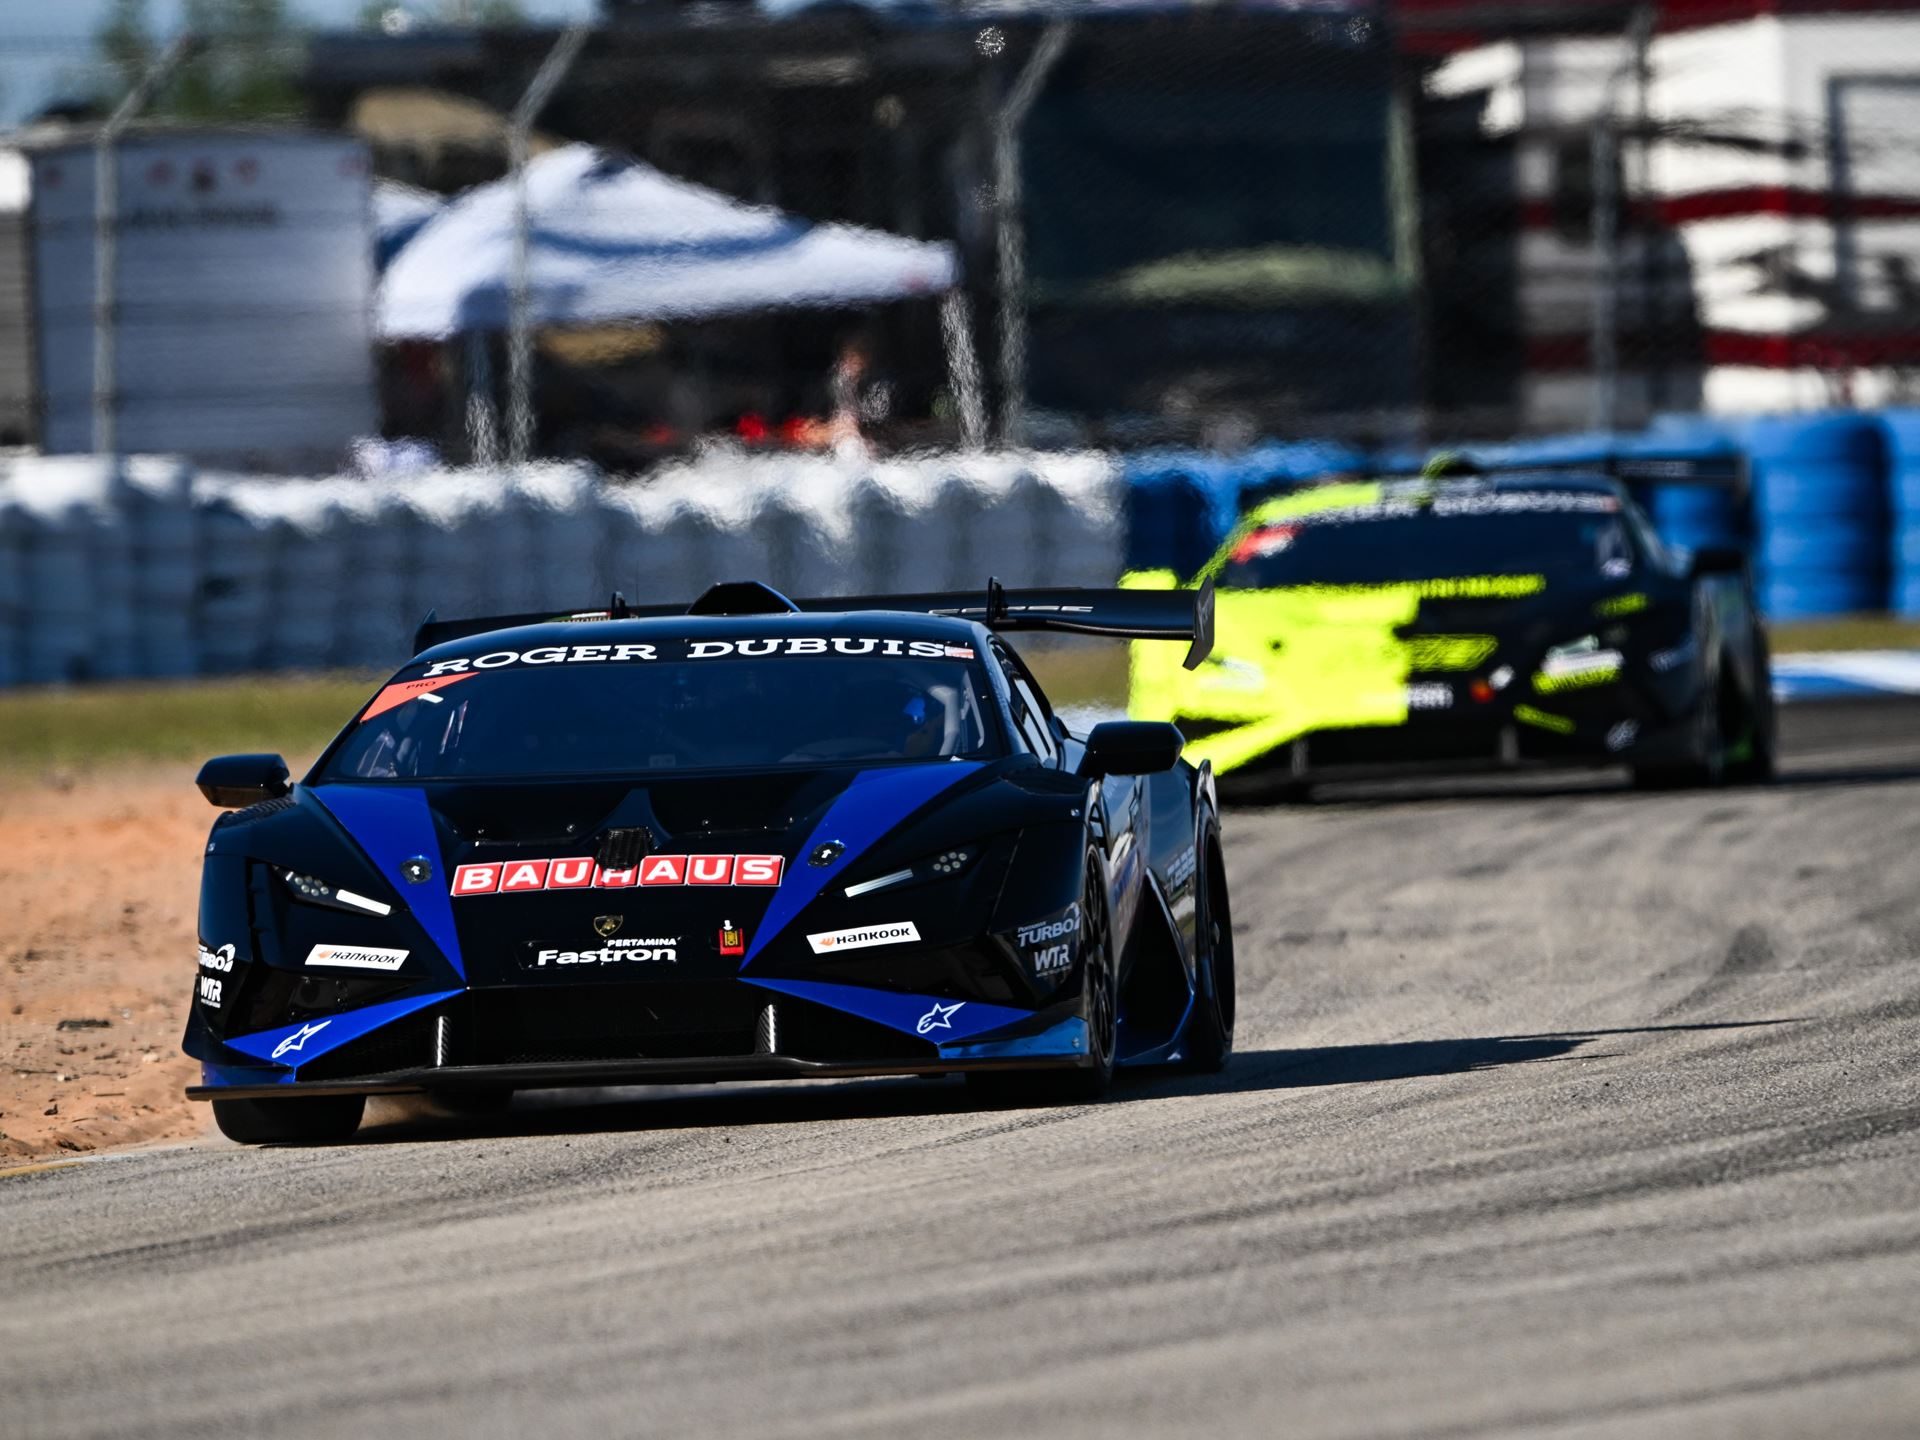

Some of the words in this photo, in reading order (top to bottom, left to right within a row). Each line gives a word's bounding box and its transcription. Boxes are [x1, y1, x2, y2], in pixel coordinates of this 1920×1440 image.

[422, 643, 658, 678] ROGER
[687, 637, 945, 659] DUBUIS
[405, 680, 437, 690] PRO
[460, 858, 775, 890] BAUHAUS
[607, 938, 677, 948] PERTAMINA
[1017, 918, 1075, 948] TURBO
[537, 947, 677, 966] Fastron
[1033, 943, 1071, 972] WTR
[200, 975, 223, 1002] WTR
